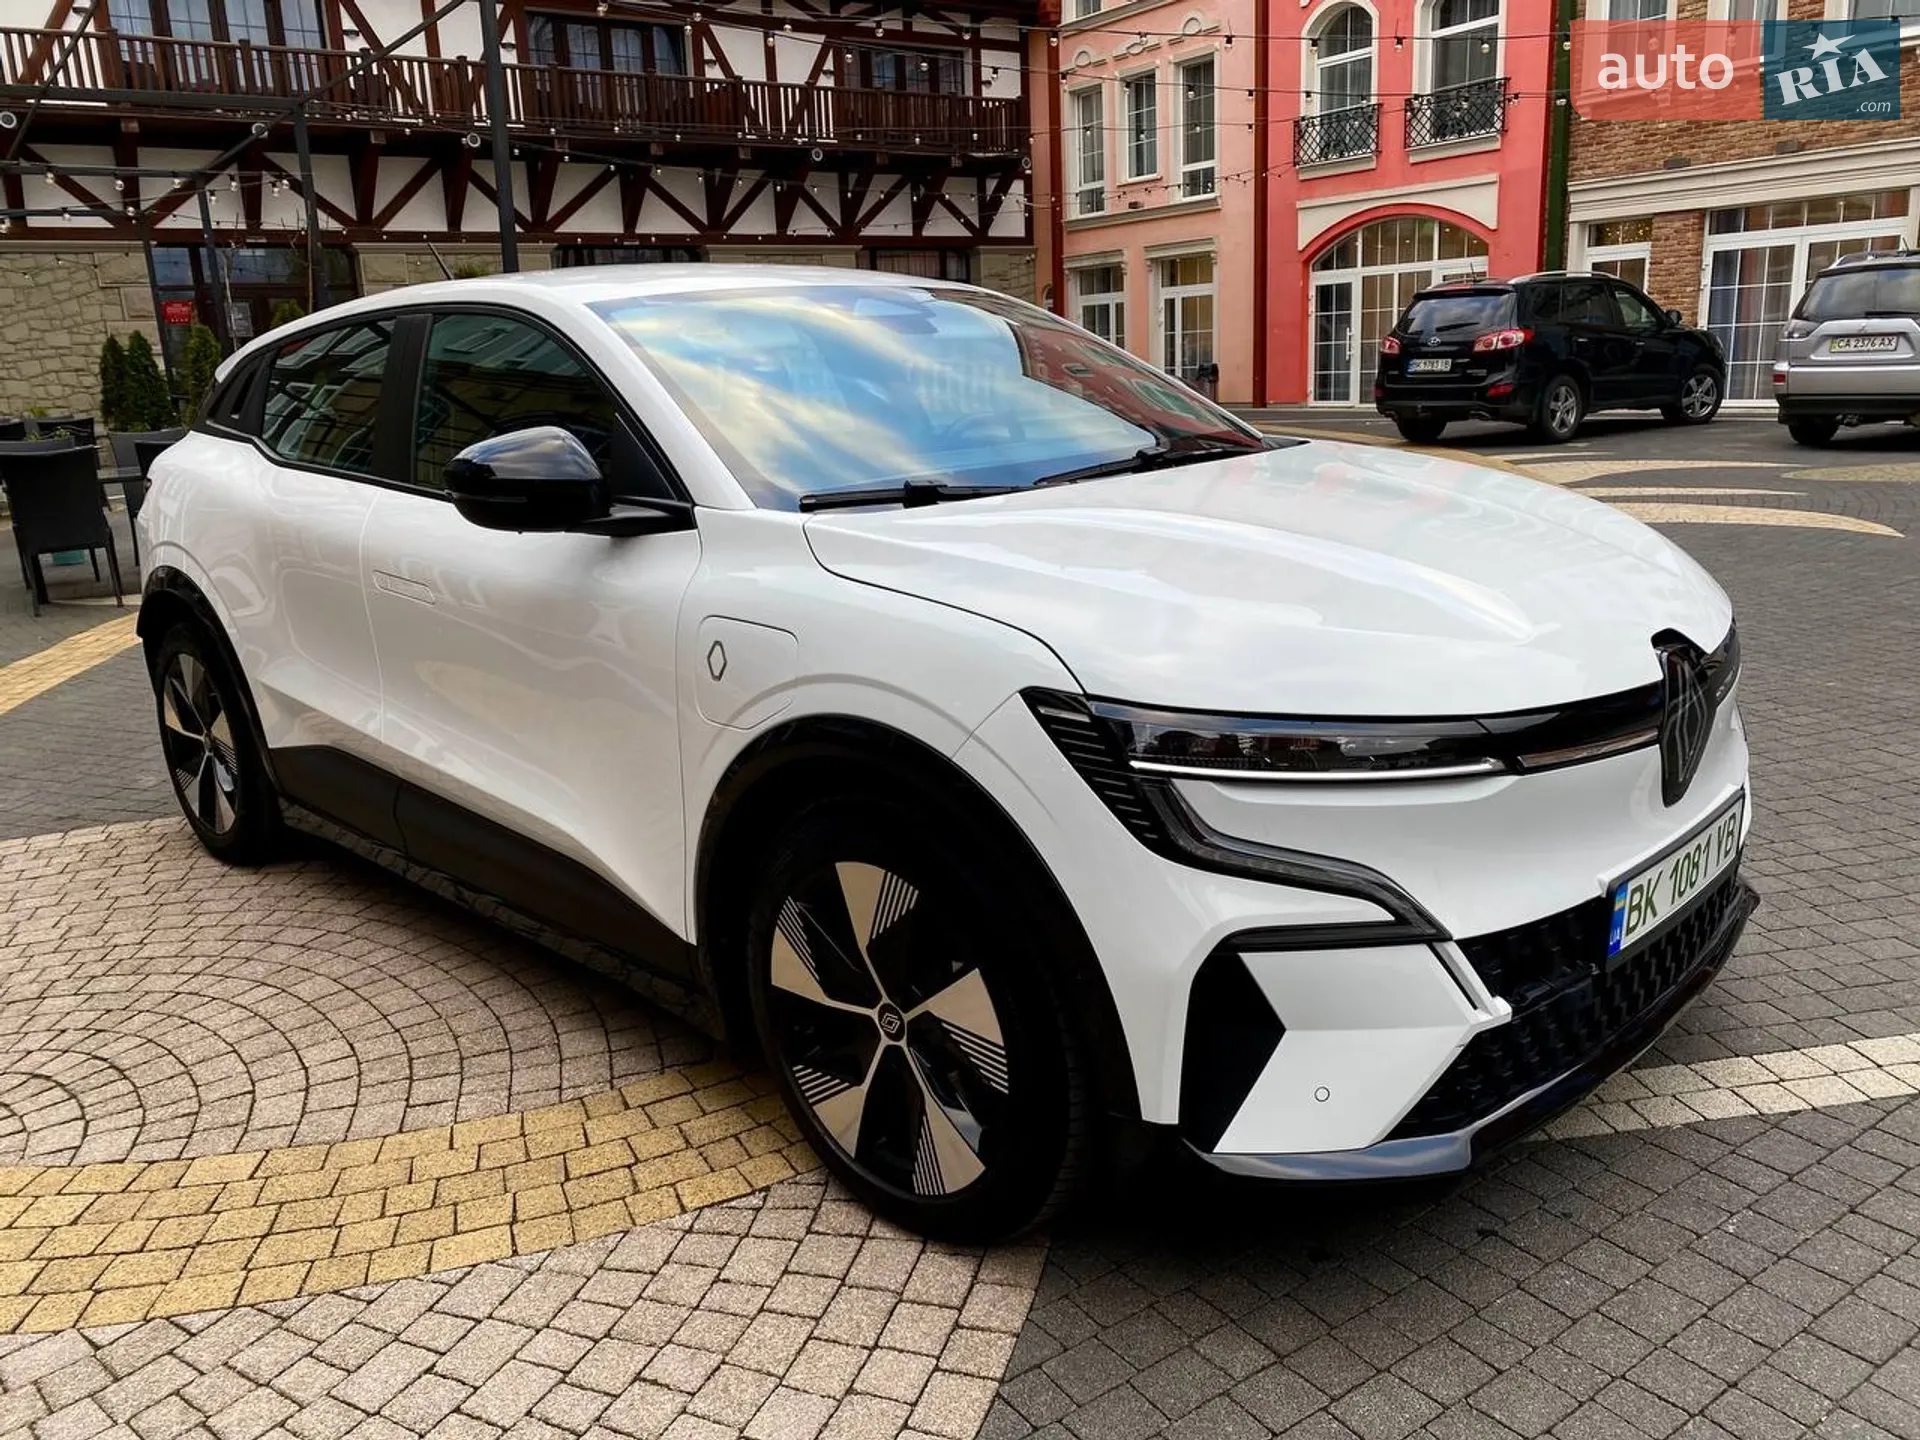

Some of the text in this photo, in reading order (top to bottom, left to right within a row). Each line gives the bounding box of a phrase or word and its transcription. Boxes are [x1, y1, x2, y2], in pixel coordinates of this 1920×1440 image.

[1626, 812, 1737, 937] BK 1081 YB
